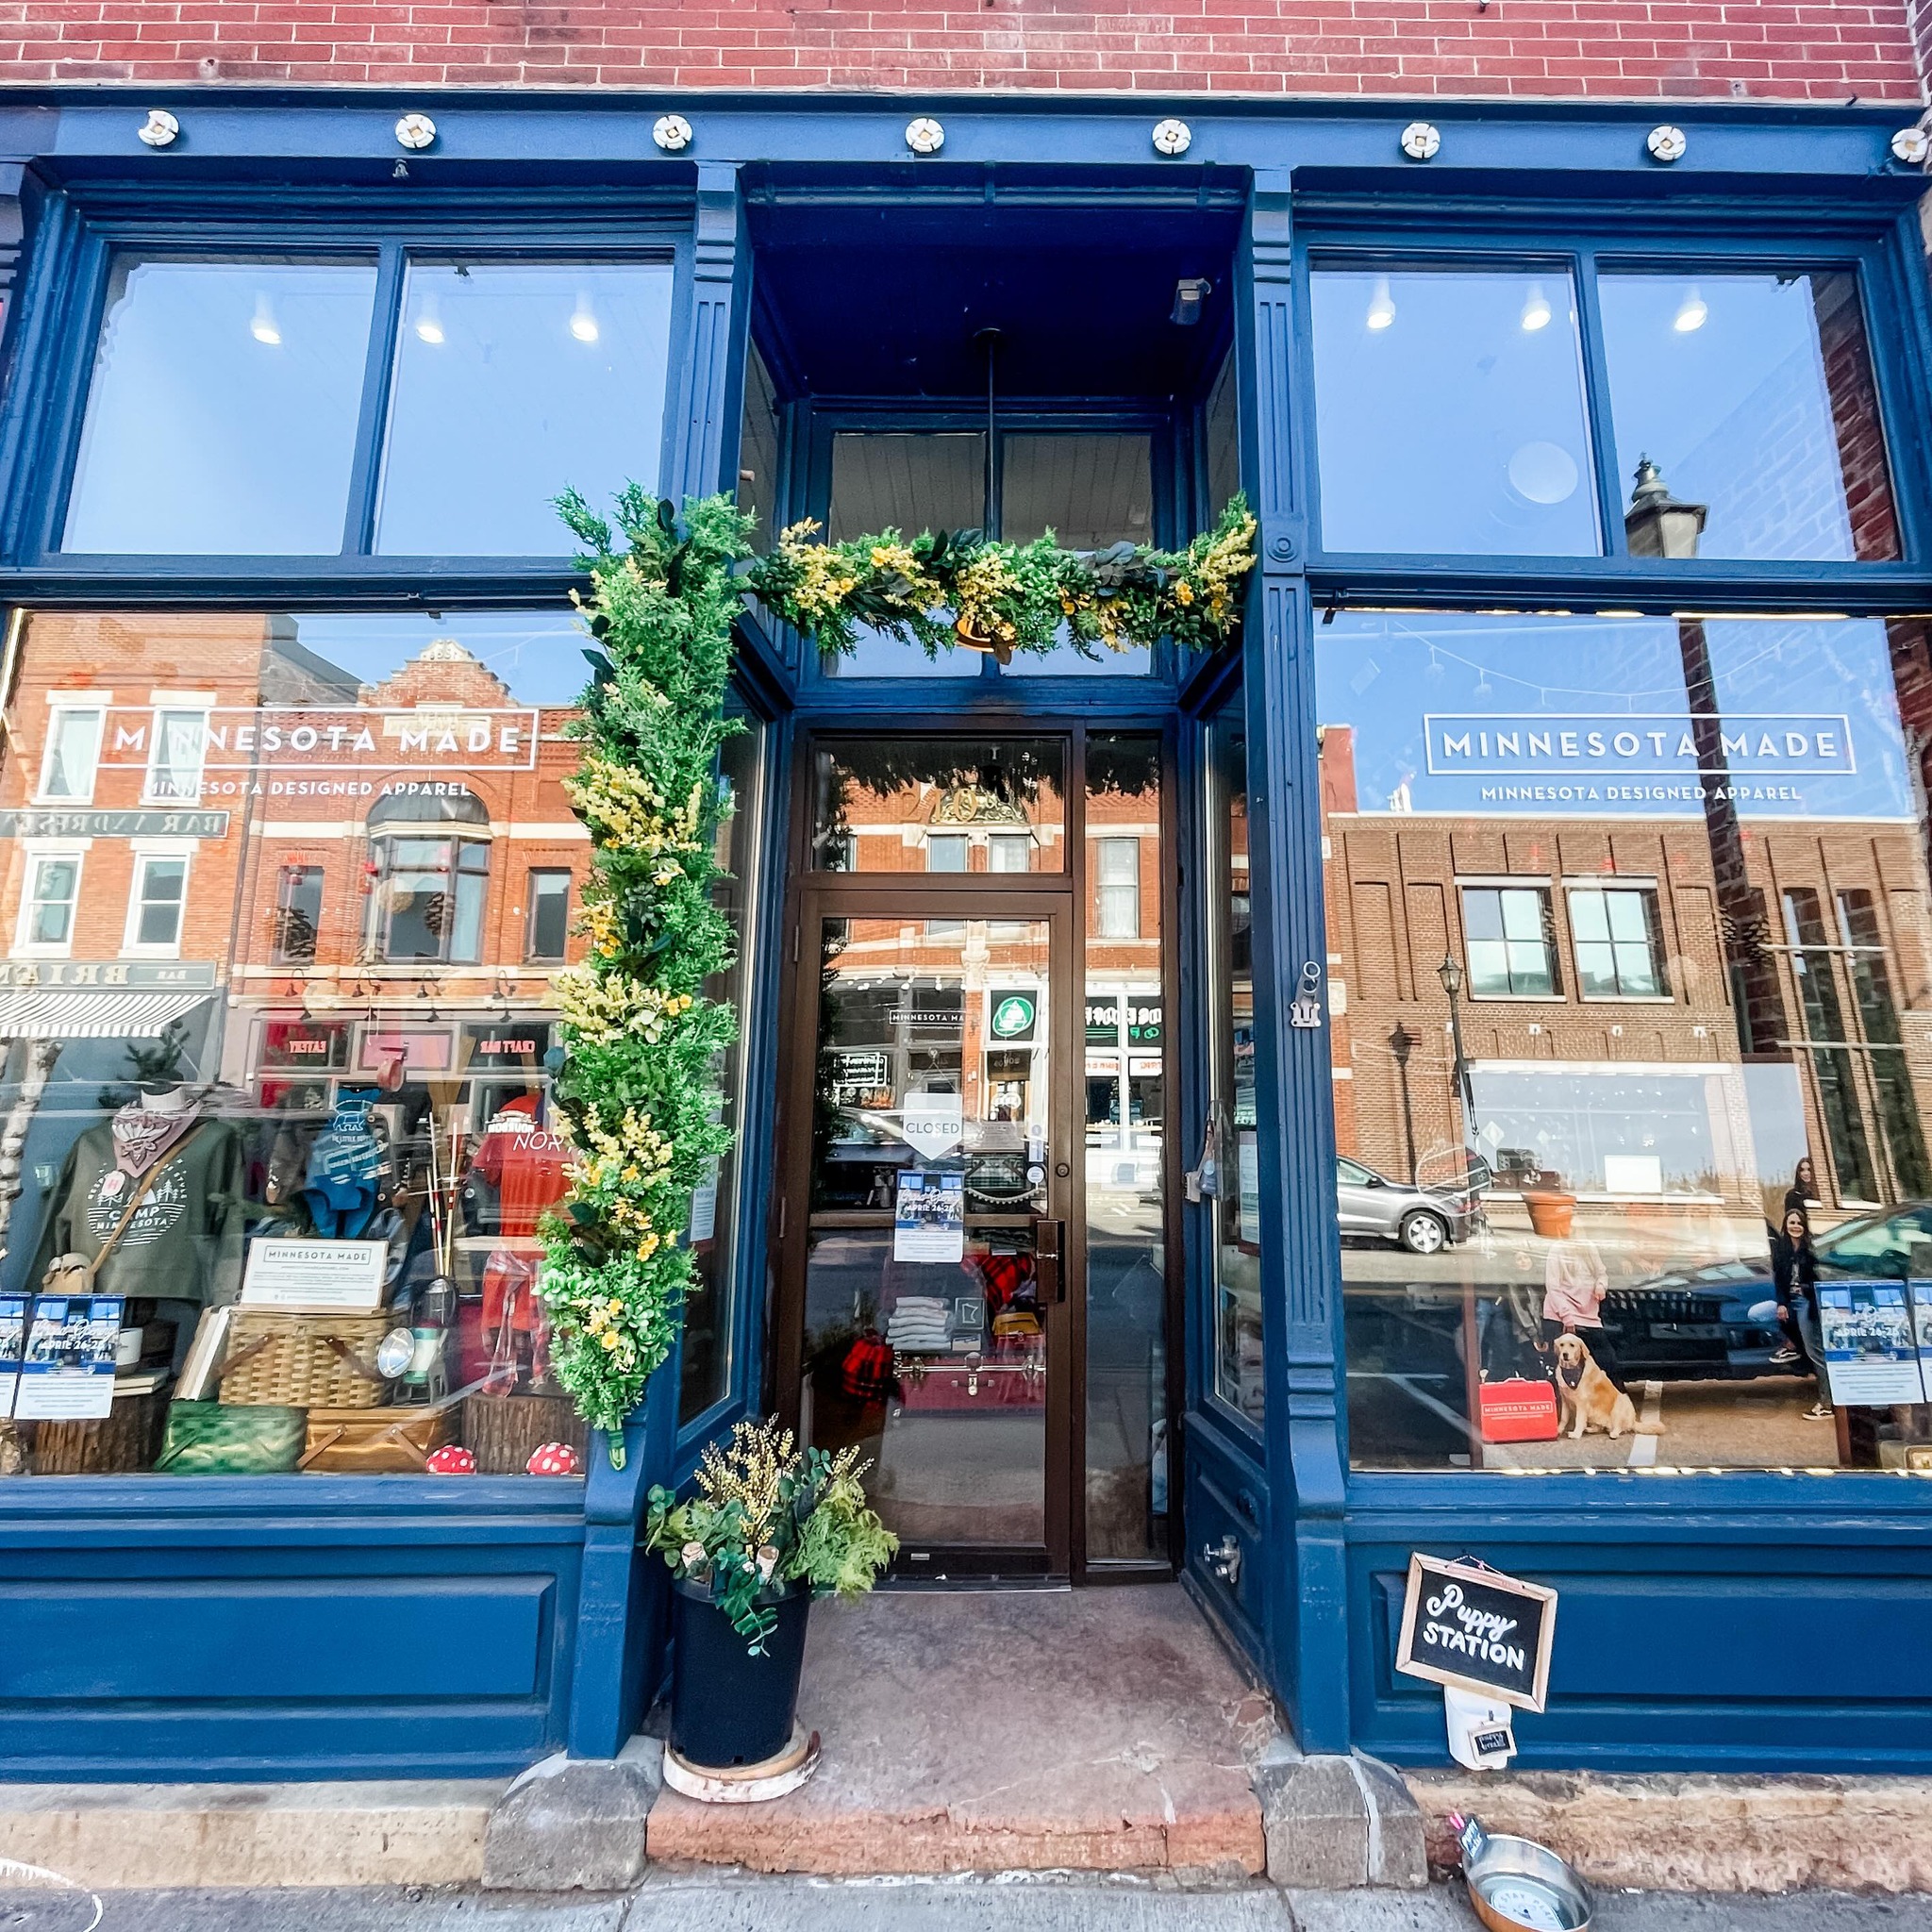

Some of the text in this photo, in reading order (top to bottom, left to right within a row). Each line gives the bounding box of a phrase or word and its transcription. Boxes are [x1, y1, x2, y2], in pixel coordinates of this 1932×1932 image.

[115, 725, 520, 753] MNNESOTA MADE
[1442, 731, 1838, 758] MINNESOTA MADE
[272, 782, 373, 796] DESIGNED
[379, 782, 472, 796] APPAREL
[1481, 786, 1803, 801] MINNESOTA DESIGNED APPAREL
[906, 1123, 959, 1134] CLOSED
[108, 1207, 160, 1221] CMP
[96, 1217, 168, 1229] MINESOTA
[337, 1253, 367, 1261] MADE
[1425, 1583, 1519, 1642] Puppy
[1423, 1621, 1525, 1672] STATION
